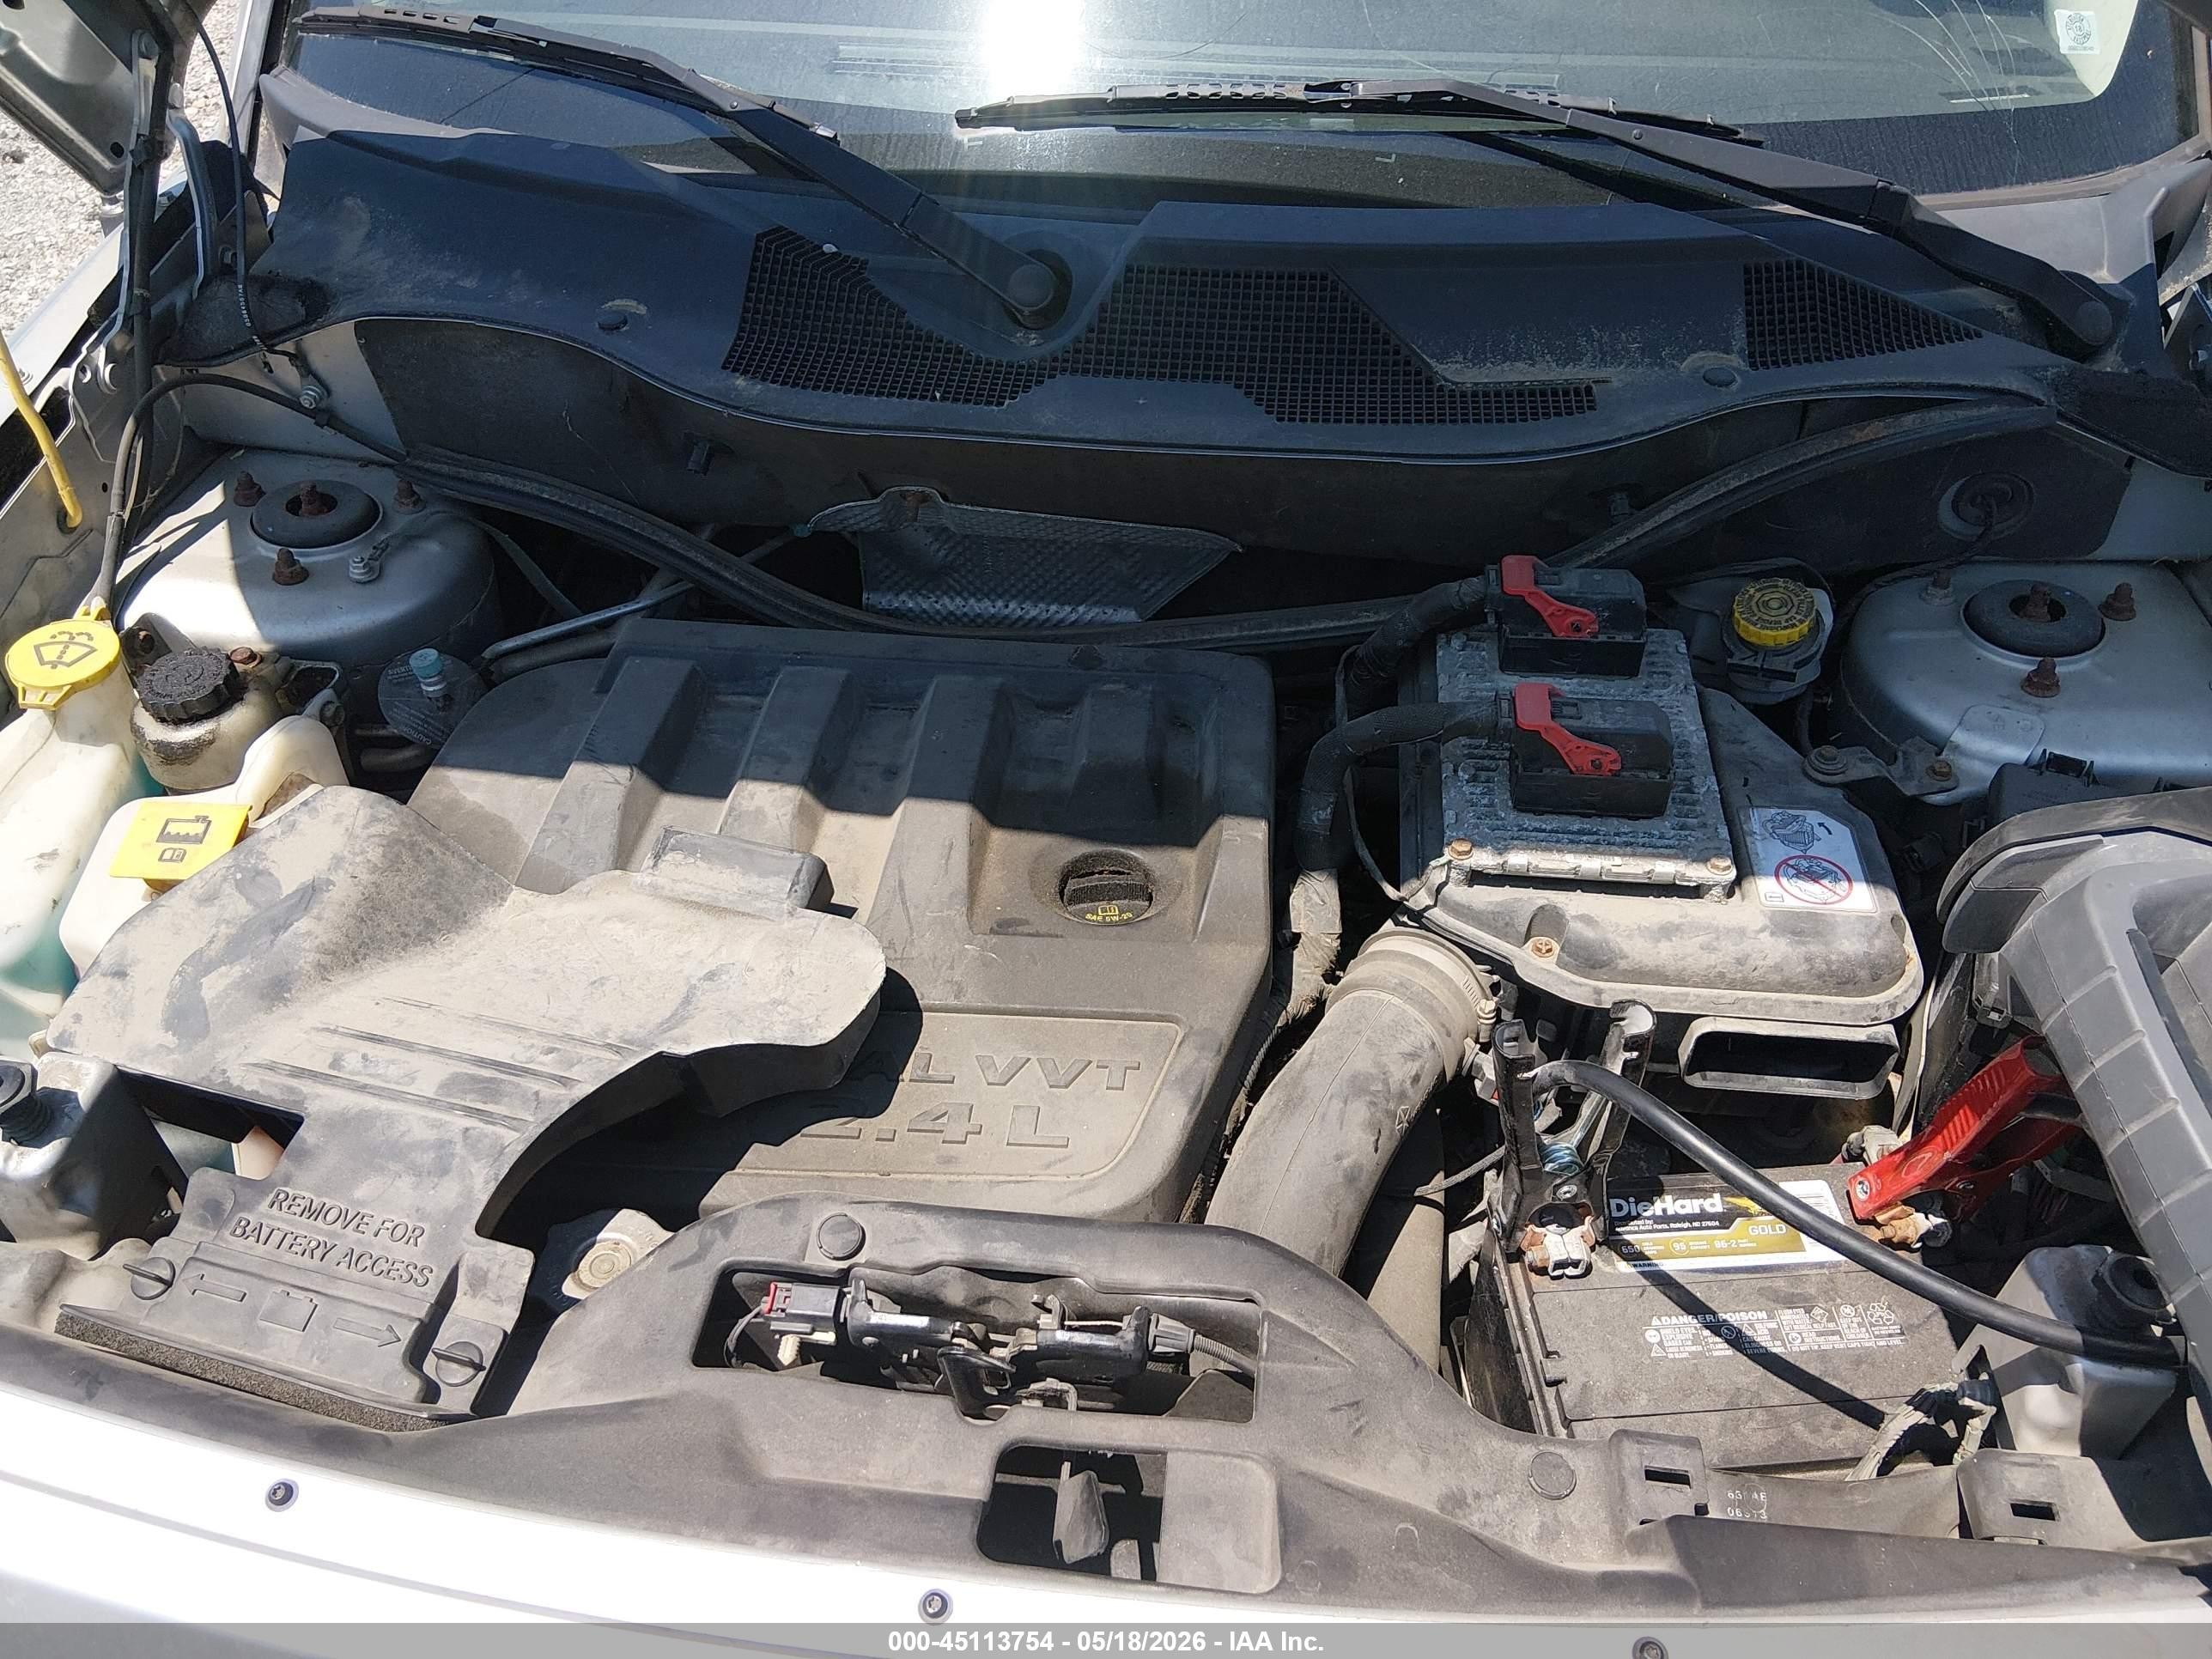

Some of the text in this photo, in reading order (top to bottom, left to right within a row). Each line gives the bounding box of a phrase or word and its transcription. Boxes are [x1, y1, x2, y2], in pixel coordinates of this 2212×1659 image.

[1085, 913, 1103, 921] SAE
[975, 1054, 1140, 1091] VVT
[268, 1188, 425, 1248] REMOVE FOR
[1609, 1193, 1723, 1218] DieHard
[1748, 1224, 1787, 1236] GOLD
[228, 1216, 434, 1288] BATTERY ACCESS
[1661, 1310, 1768, 1324] DANGER/POISON
